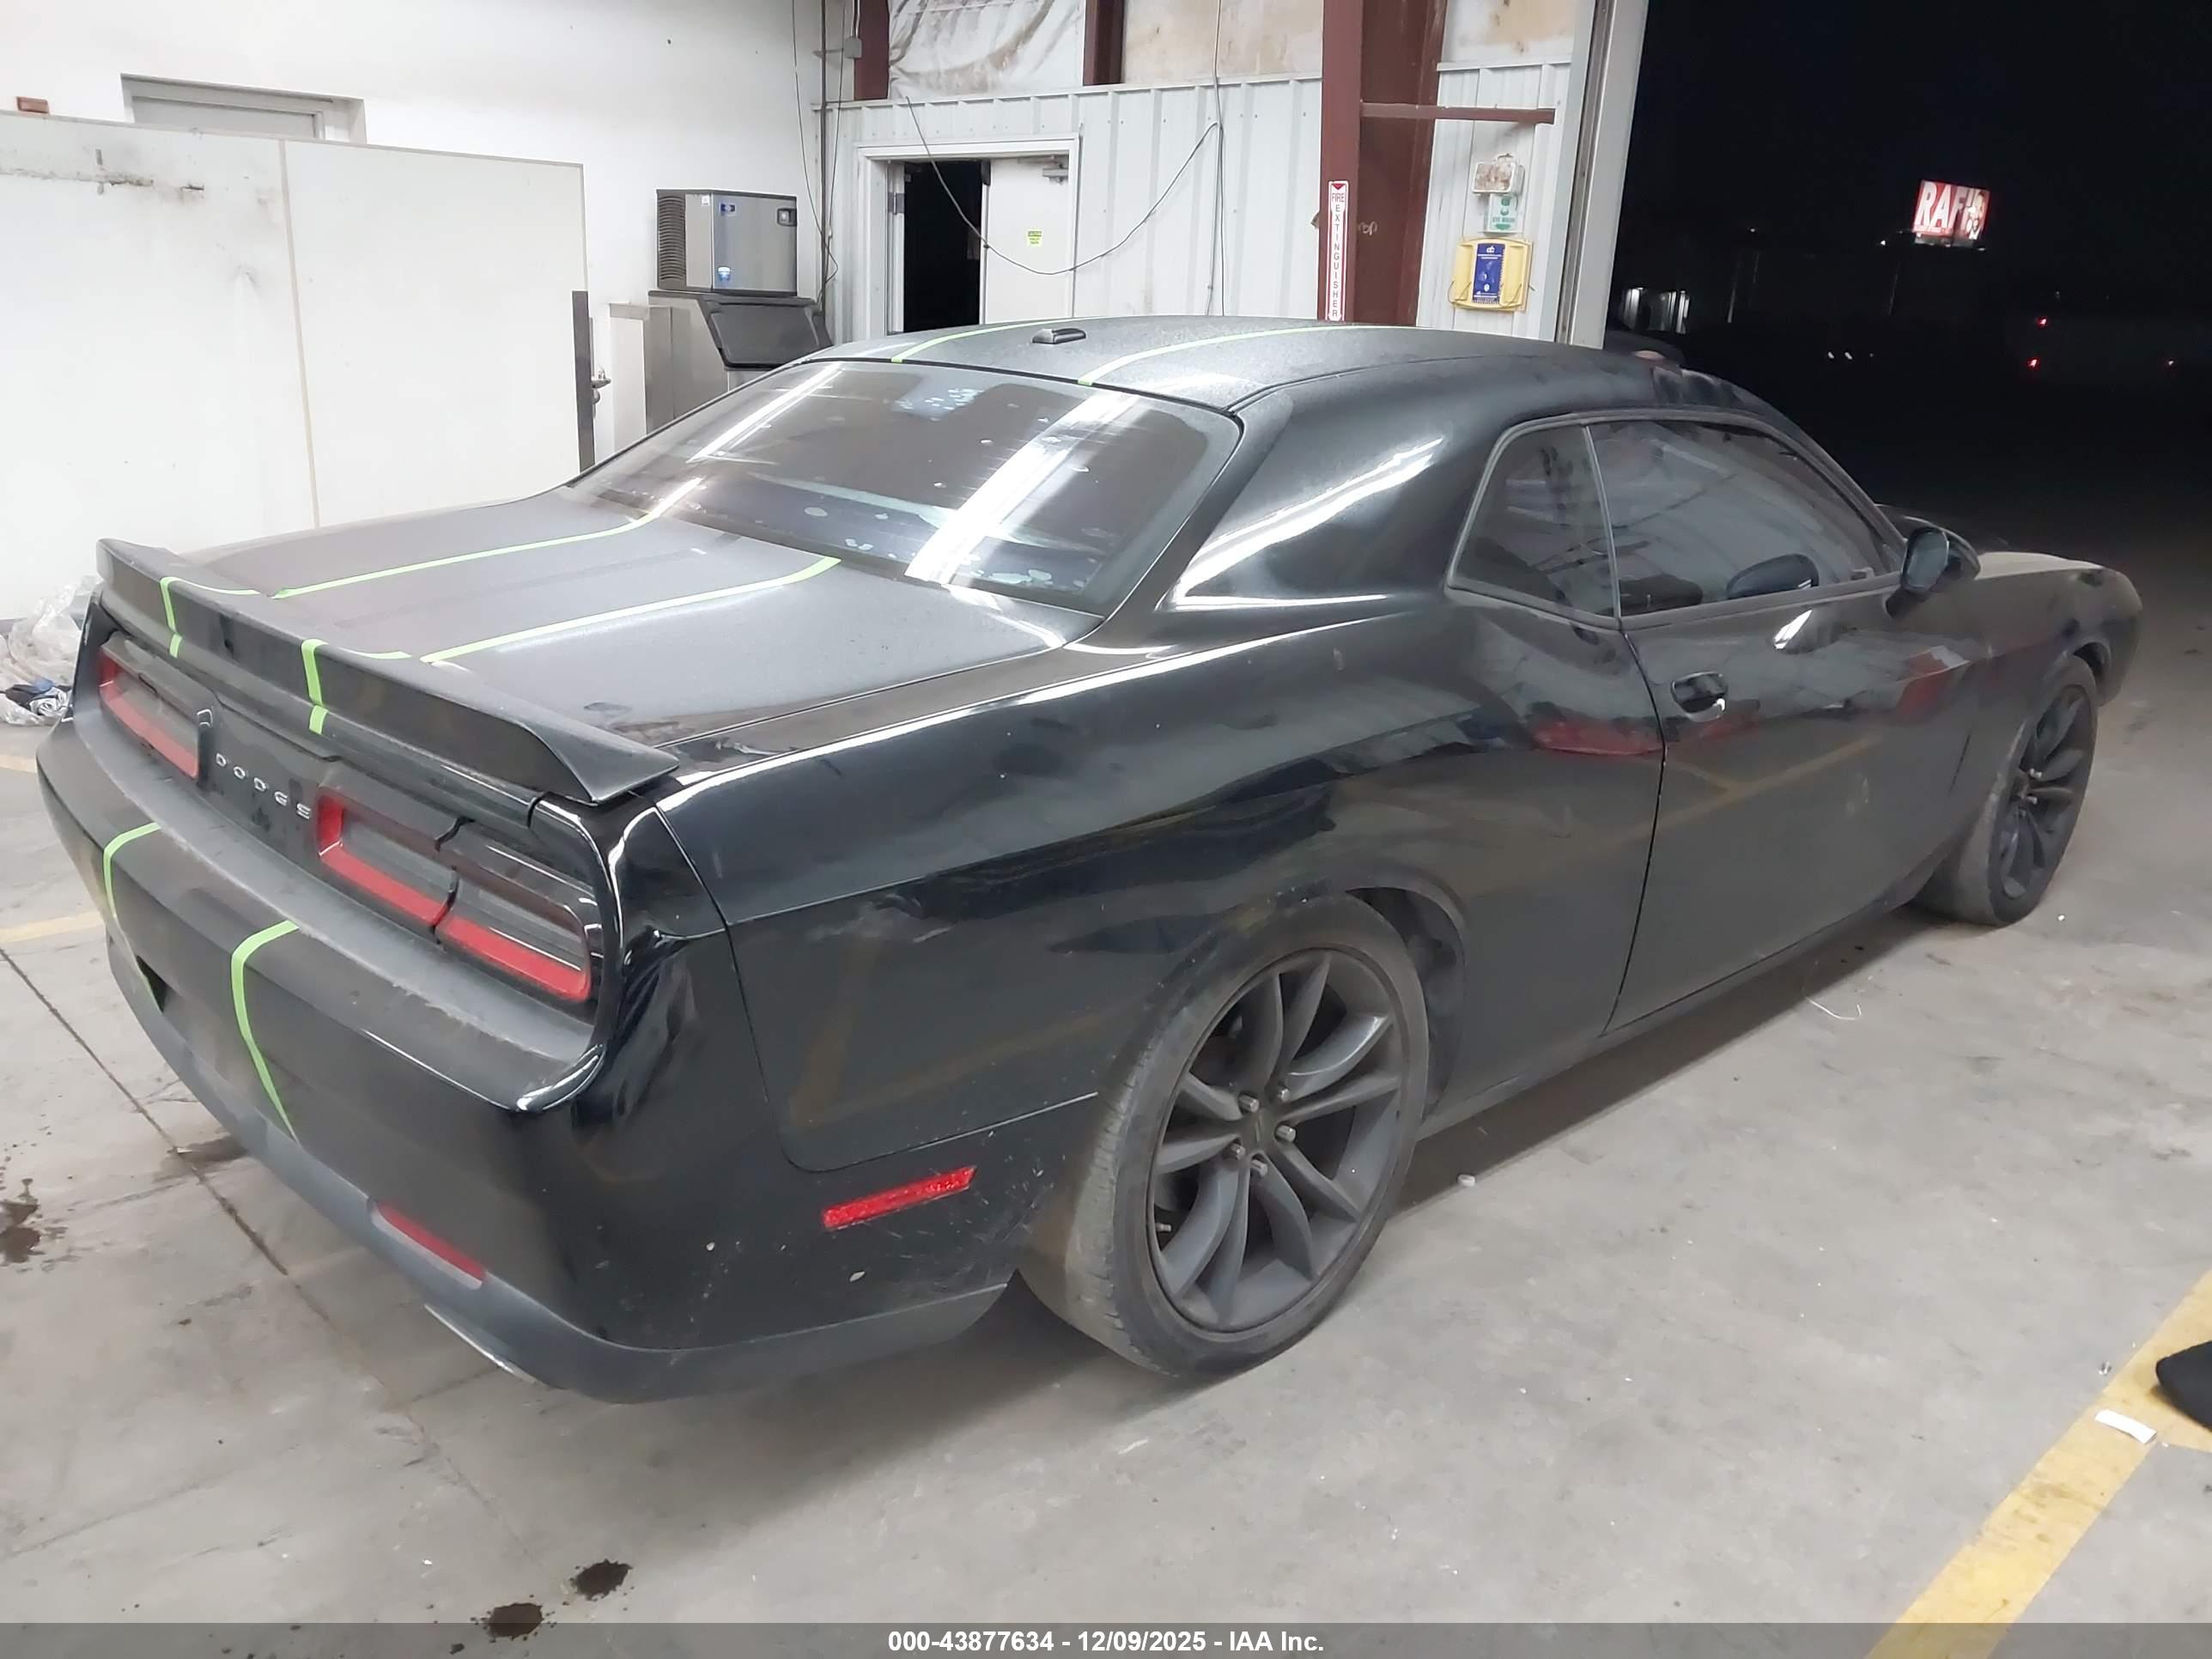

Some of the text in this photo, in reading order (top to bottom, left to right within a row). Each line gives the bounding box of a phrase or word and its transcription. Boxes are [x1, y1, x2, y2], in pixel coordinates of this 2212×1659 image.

[1332, 192, 1346, 203] FIRE
[1332, 204, 1341, 317] EXTINGUISHER
[216, 752, 312, 820] DODGE
